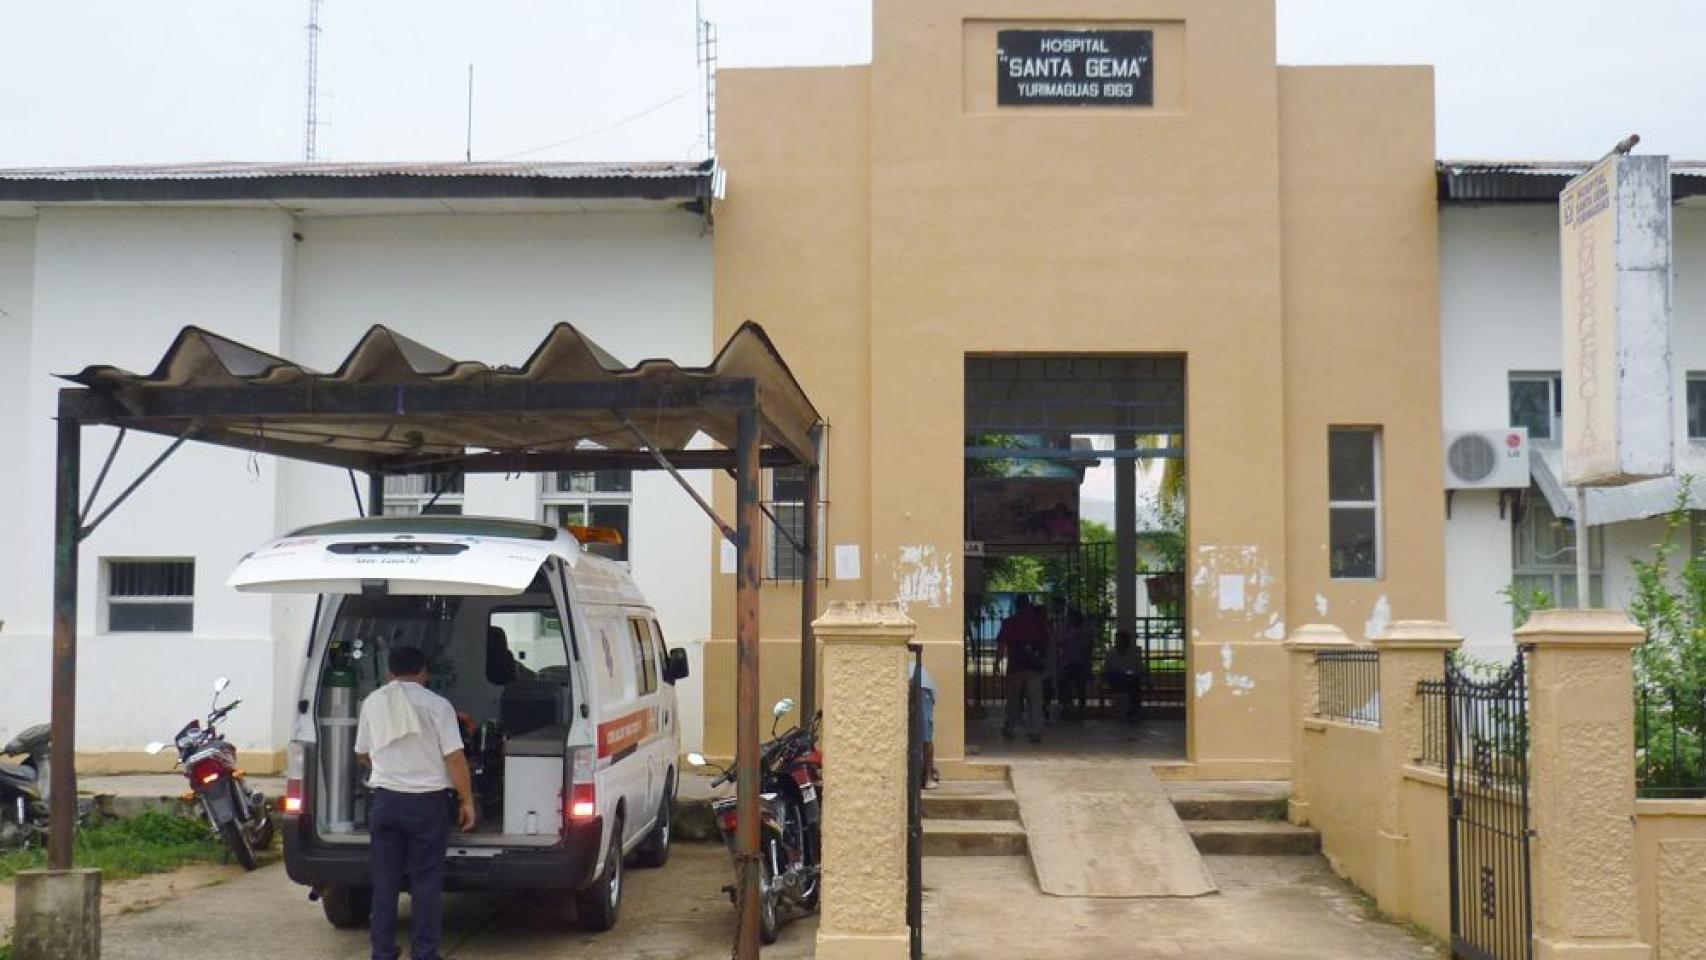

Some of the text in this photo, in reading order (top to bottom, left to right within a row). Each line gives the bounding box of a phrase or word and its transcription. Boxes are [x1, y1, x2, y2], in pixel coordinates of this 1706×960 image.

[1041, 39, 1108, 53] HOSPITAL
[1018, 82, 1134, 97] YURIMAGUAS 1963
